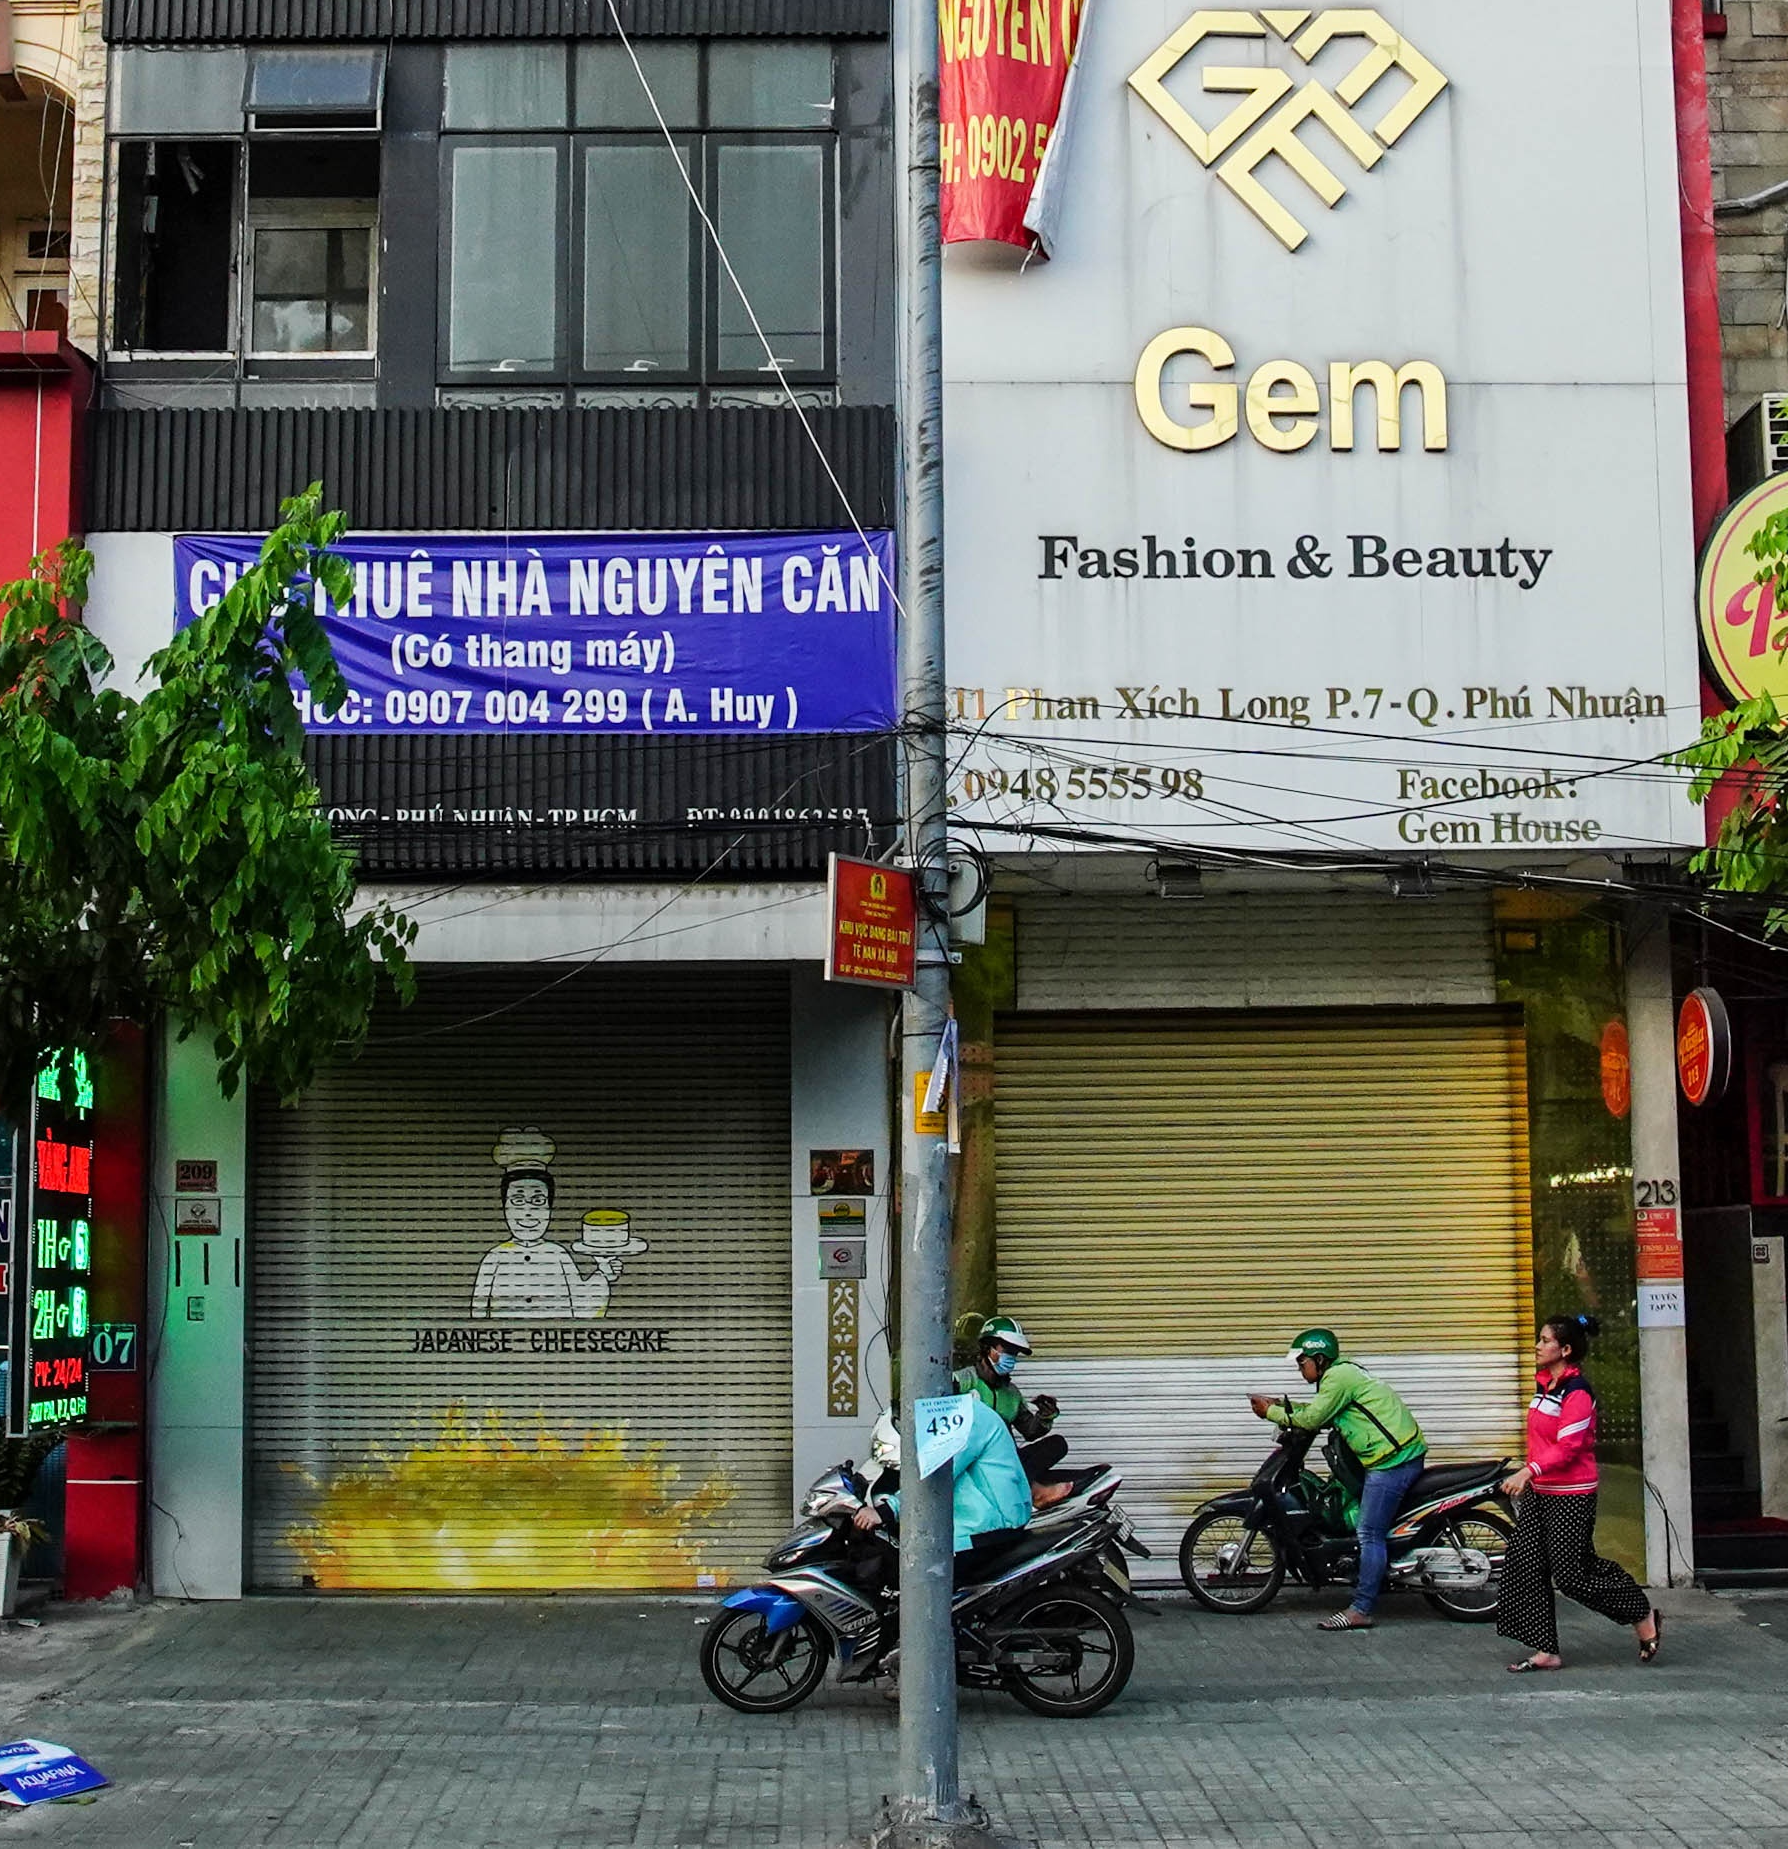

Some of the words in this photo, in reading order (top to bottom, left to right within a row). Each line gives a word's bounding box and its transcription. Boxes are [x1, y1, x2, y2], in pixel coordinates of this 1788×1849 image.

[939, 120, 962, 184] H:
[967, 114, 1026, 184] 0902
[1033, 123, 1056, 181] 5
[1134, 326, 1450, 454] Gem
[452, 548, 553, 618] NHÀ
[570, 544, 763, 616] NGUYÊN
[782, 544, 880, 614] CĂN
[1036, 535, 1276, 581] Fashion
[1286, 534, 1333, 580] &
[1346, 535, 1554, 591] Beauty
[392, 633, 453, 676] (Có
[465, 633, 572, 675] thang
[586, 630, 676, 674] máy)
[385, 689, 473, 725] 0907
[484, 689, 550, 725] 004
[562, 689, 628, 724] 299
[664, 688, 698, 723] A.
[711, 687, 775, 729] Huy
[945, 686, 987, 721] 11
[1003, 686, 1101, 721] Phan
[1115, 684, 1200, 720] Xích
[1218, 687, 1311, 728] Long
[1547, 687, 1668, 725] Nhuận
[964, 767, 1060, 802] 0948
[1066, 767, 1152, 801] 5555
[1159, 767, 1205, 801] 98
[1396, 769, 1577, 800] Facebook:
[1398, 812, 1483, 844] Gem
[1491, 812, 1602, 844] House
[179, 1164, 213, 1180] 209
[1636, 1179, 1677, 1208] 213
[37, 1219, 58, 1270] 1H
[32, 1288, 55, 1340] 2H
[92, 1331, 134, 1367] 07
[414, 1328, 513, 1352] JAPANESE
[530, 1328, 671, 1352] CHEESECAKE
[52, 1356, 82, 1390] 24/24
[926, 1413, 964, 1437] 439
[15, 1763, 87, 1791] AQUAFINA
